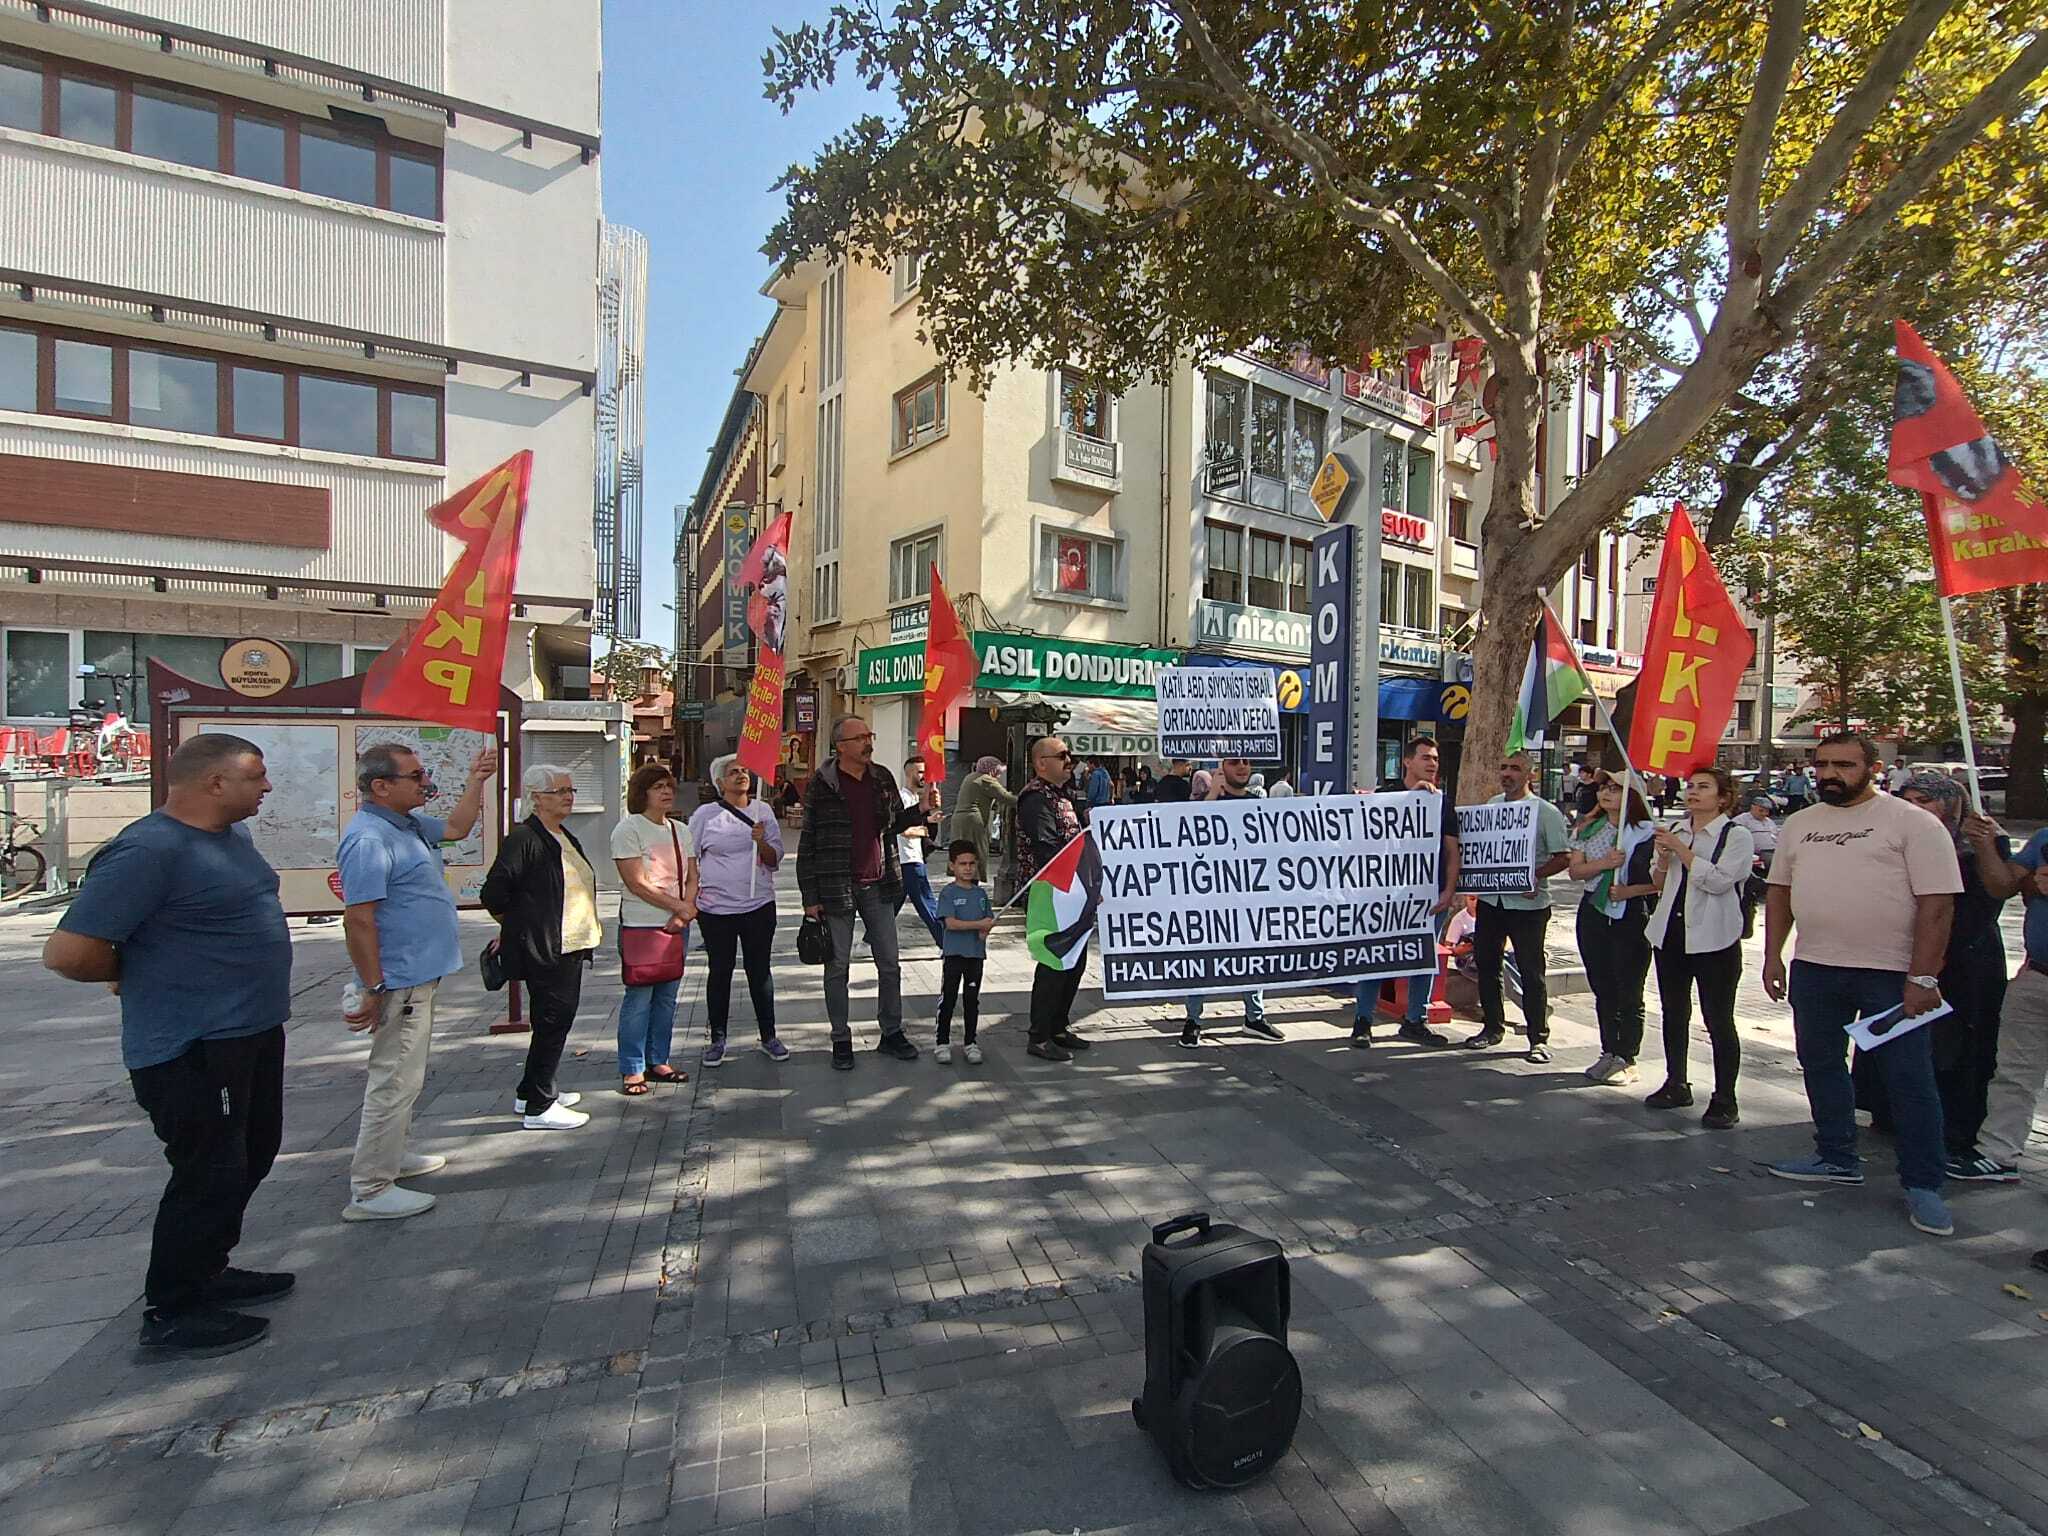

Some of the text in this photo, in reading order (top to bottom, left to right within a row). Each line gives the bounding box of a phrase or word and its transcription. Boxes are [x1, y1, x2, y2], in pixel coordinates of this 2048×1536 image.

[1382, 512, 1426, 541] SUYU
[868, 659, 891, 685] ASIL
[982, 646, 1040, 678] ASIL
[1161, 671, 1273, 702] KATİL ABD, SİYONİST İSRAİL
[760, 709, 780, 732] gibi
[1163, 704, 1275, 731] ORTADOĞUDAN DEFOL
[1062, 735, 1113, 753] ASIL
[1163, 735, 1276, 756] HALKIN KURTULUŞ PARTİSİ
[1099, 798, 1434, 851] KATİL ABD, SİYONİST İSRAİL
[1494, 806, 1531, 830] ABD-AB
[1102, 852, 1435, 898] YAPTIĞINIZ SOYKIRIMIN
[1464, 872, 1500, 890] KURTULUŞ
[1500, 869, 1529, 887] PARTİSİ
[1107, 892, 1432, 948] HESABINI VERECEKSİNİZ!
[1111, 938, 1424, 982] HALKIN KURTULUŞ PARTİSİ
